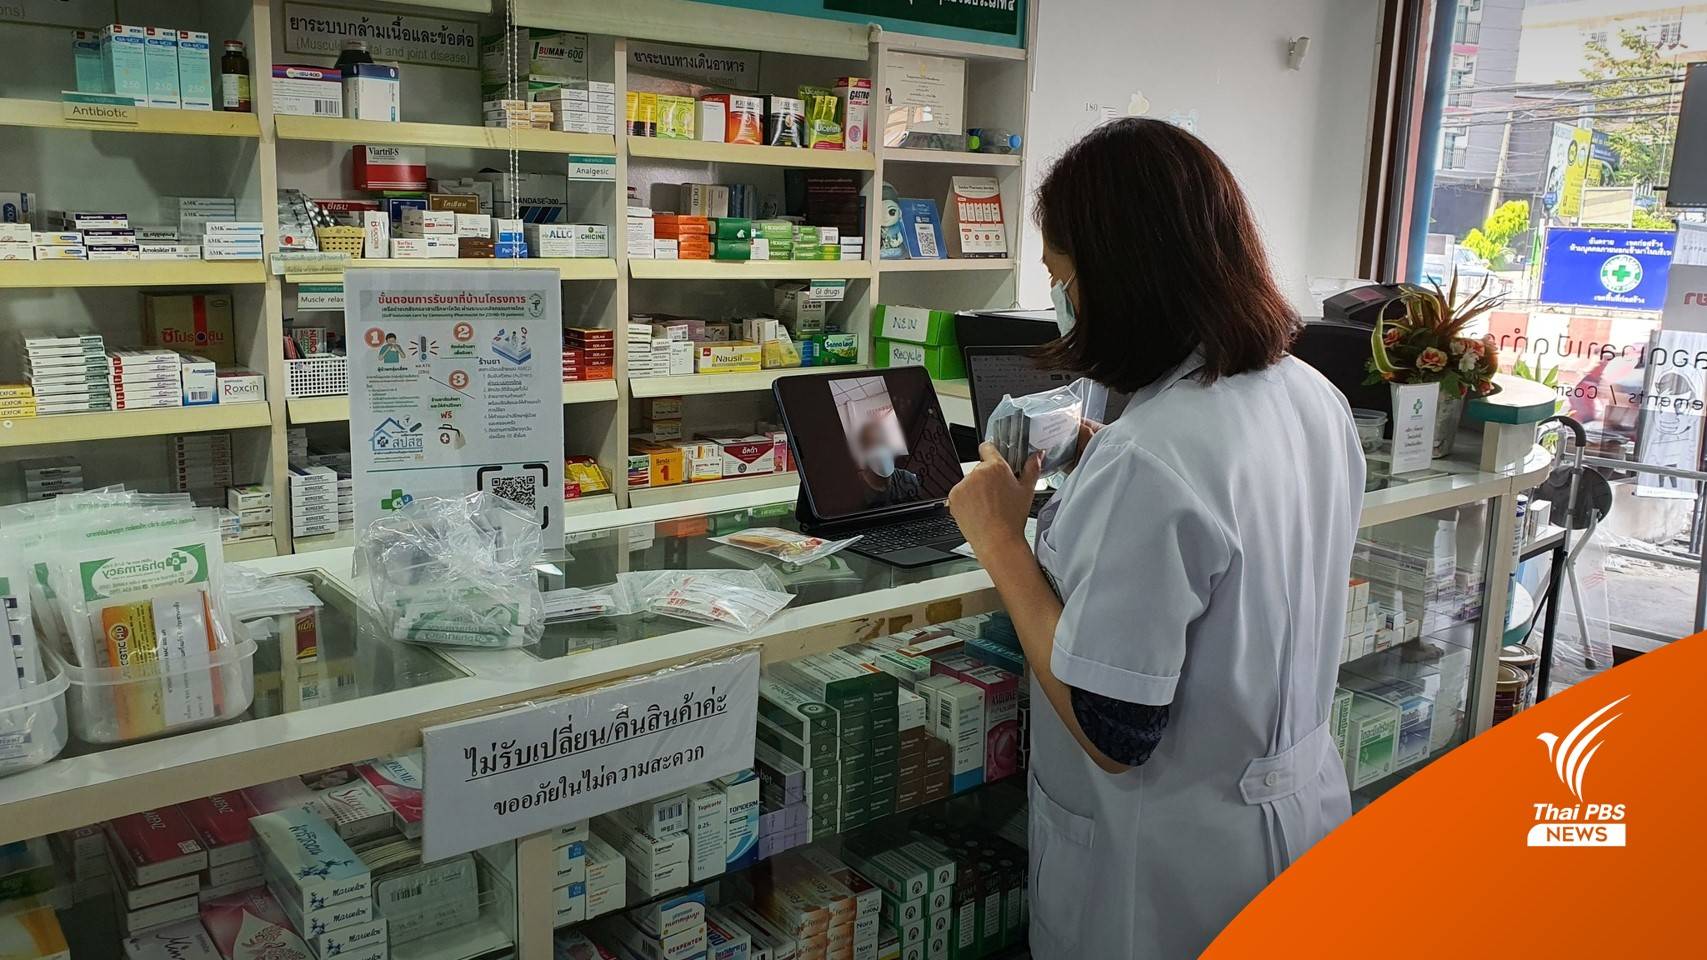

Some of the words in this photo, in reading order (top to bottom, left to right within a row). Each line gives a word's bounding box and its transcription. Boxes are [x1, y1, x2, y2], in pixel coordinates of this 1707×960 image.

[289, 15, 475, 48] ยาระบบกล้ามเนื้อและข้อต่อ
[386, 46, 401, 57] and
[407, 47, 427, 62] joint
[430, 51, 471, 65] disease)
[634, 49, 745, 73] ยาระบบทางเดินอาหาร
[850, 90, 869, 100] GASTRO
[72, 106, 128, 118] Antibiotic
[368, 147, 399, 156] Viartril-S
[576, 167, 609, 176] Analgesic
[823, 287, 840, 297] drugs
[892, 316, 918, 331] NEW
[370, 331, 380, 345] 1
[457, 325, 470, 339] 2
[478, 357, 501, 365] ร้านยา
[715, 353, 743, 363] Nausil
[893, 348, 922, 363] Recycle
[452, 372, 465, 387] 3
[440, 410, 453, 419] ฟรี
[392, 437, 423, 448] สปสช
[660, 465, 669, 481] 1
[464, 686, 729, 778] ไม่รับเปลี่ยน/คืนสินค้าค่ะ
[492, 744, 705, 816] ขออภัยในไม่ความสะดวก
[332, 882, 367, 897] Marvelon
[333, 908, 367, 922] Marvelon
[348, 928, 383, 942] Marvelon
